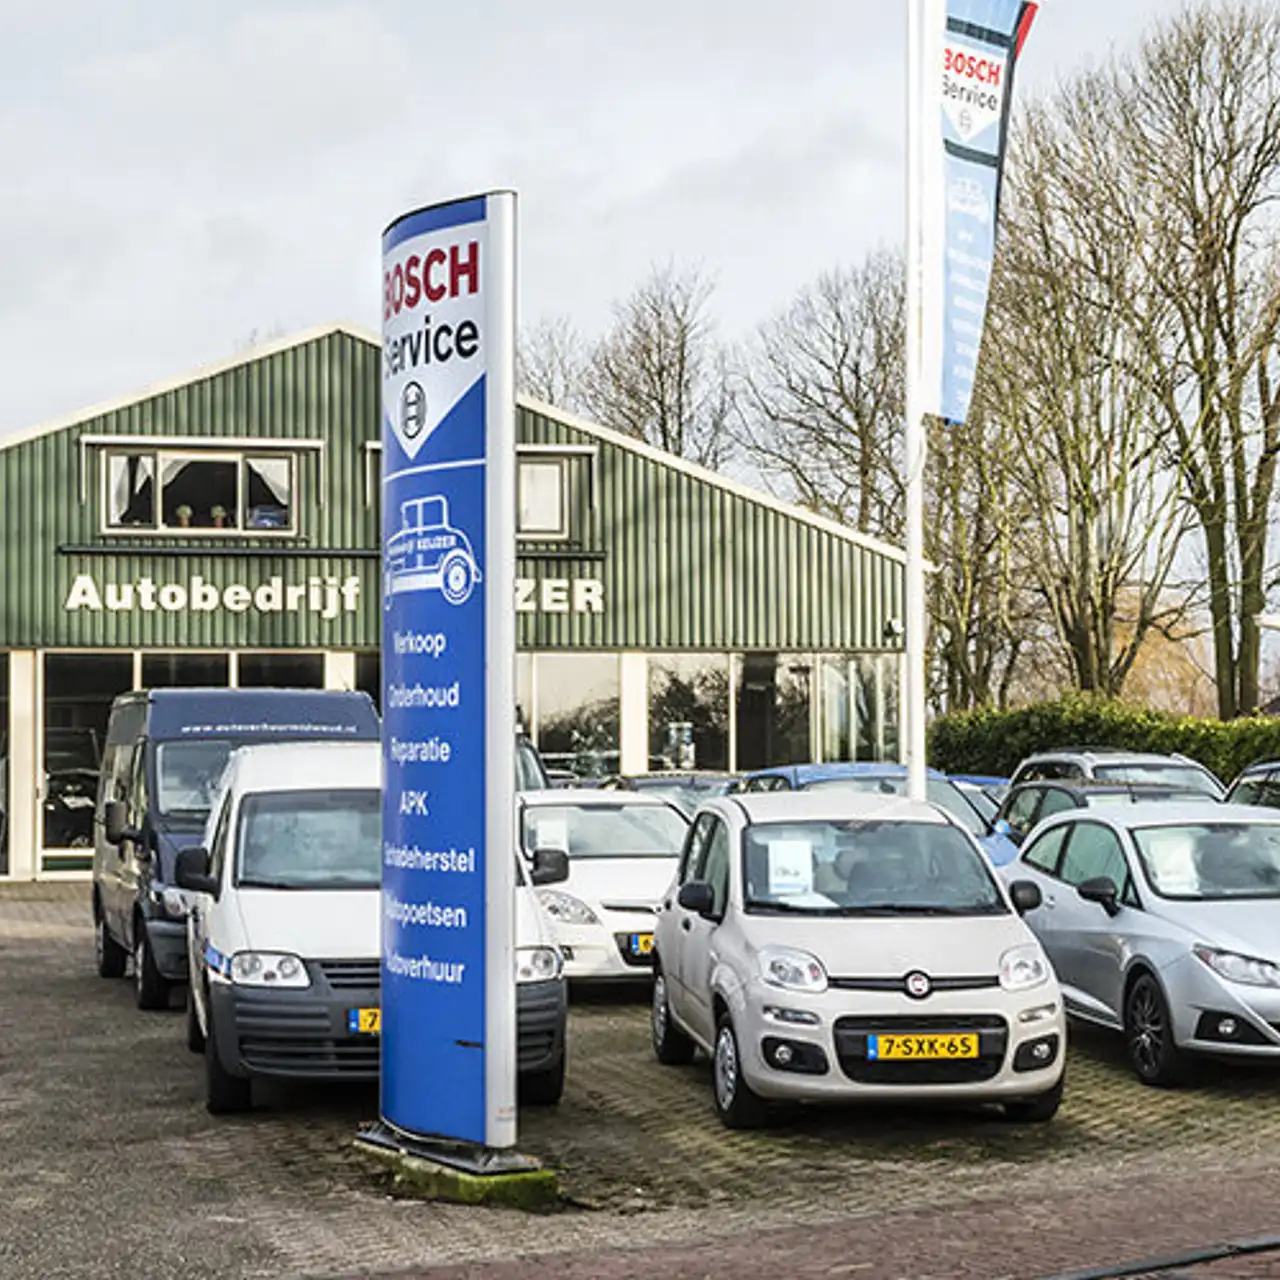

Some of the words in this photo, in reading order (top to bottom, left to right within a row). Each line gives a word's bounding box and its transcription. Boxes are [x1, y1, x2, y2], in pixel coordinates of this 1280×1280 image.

[944, 48, 1001, 86] BOSCH
[942, 74, 998, 111] Service
[65, 574, 360, 619] Autobedrijf
[399, 790, 430, 816] APK
[884, 1037, 972, 1056] 7-SXK-65
